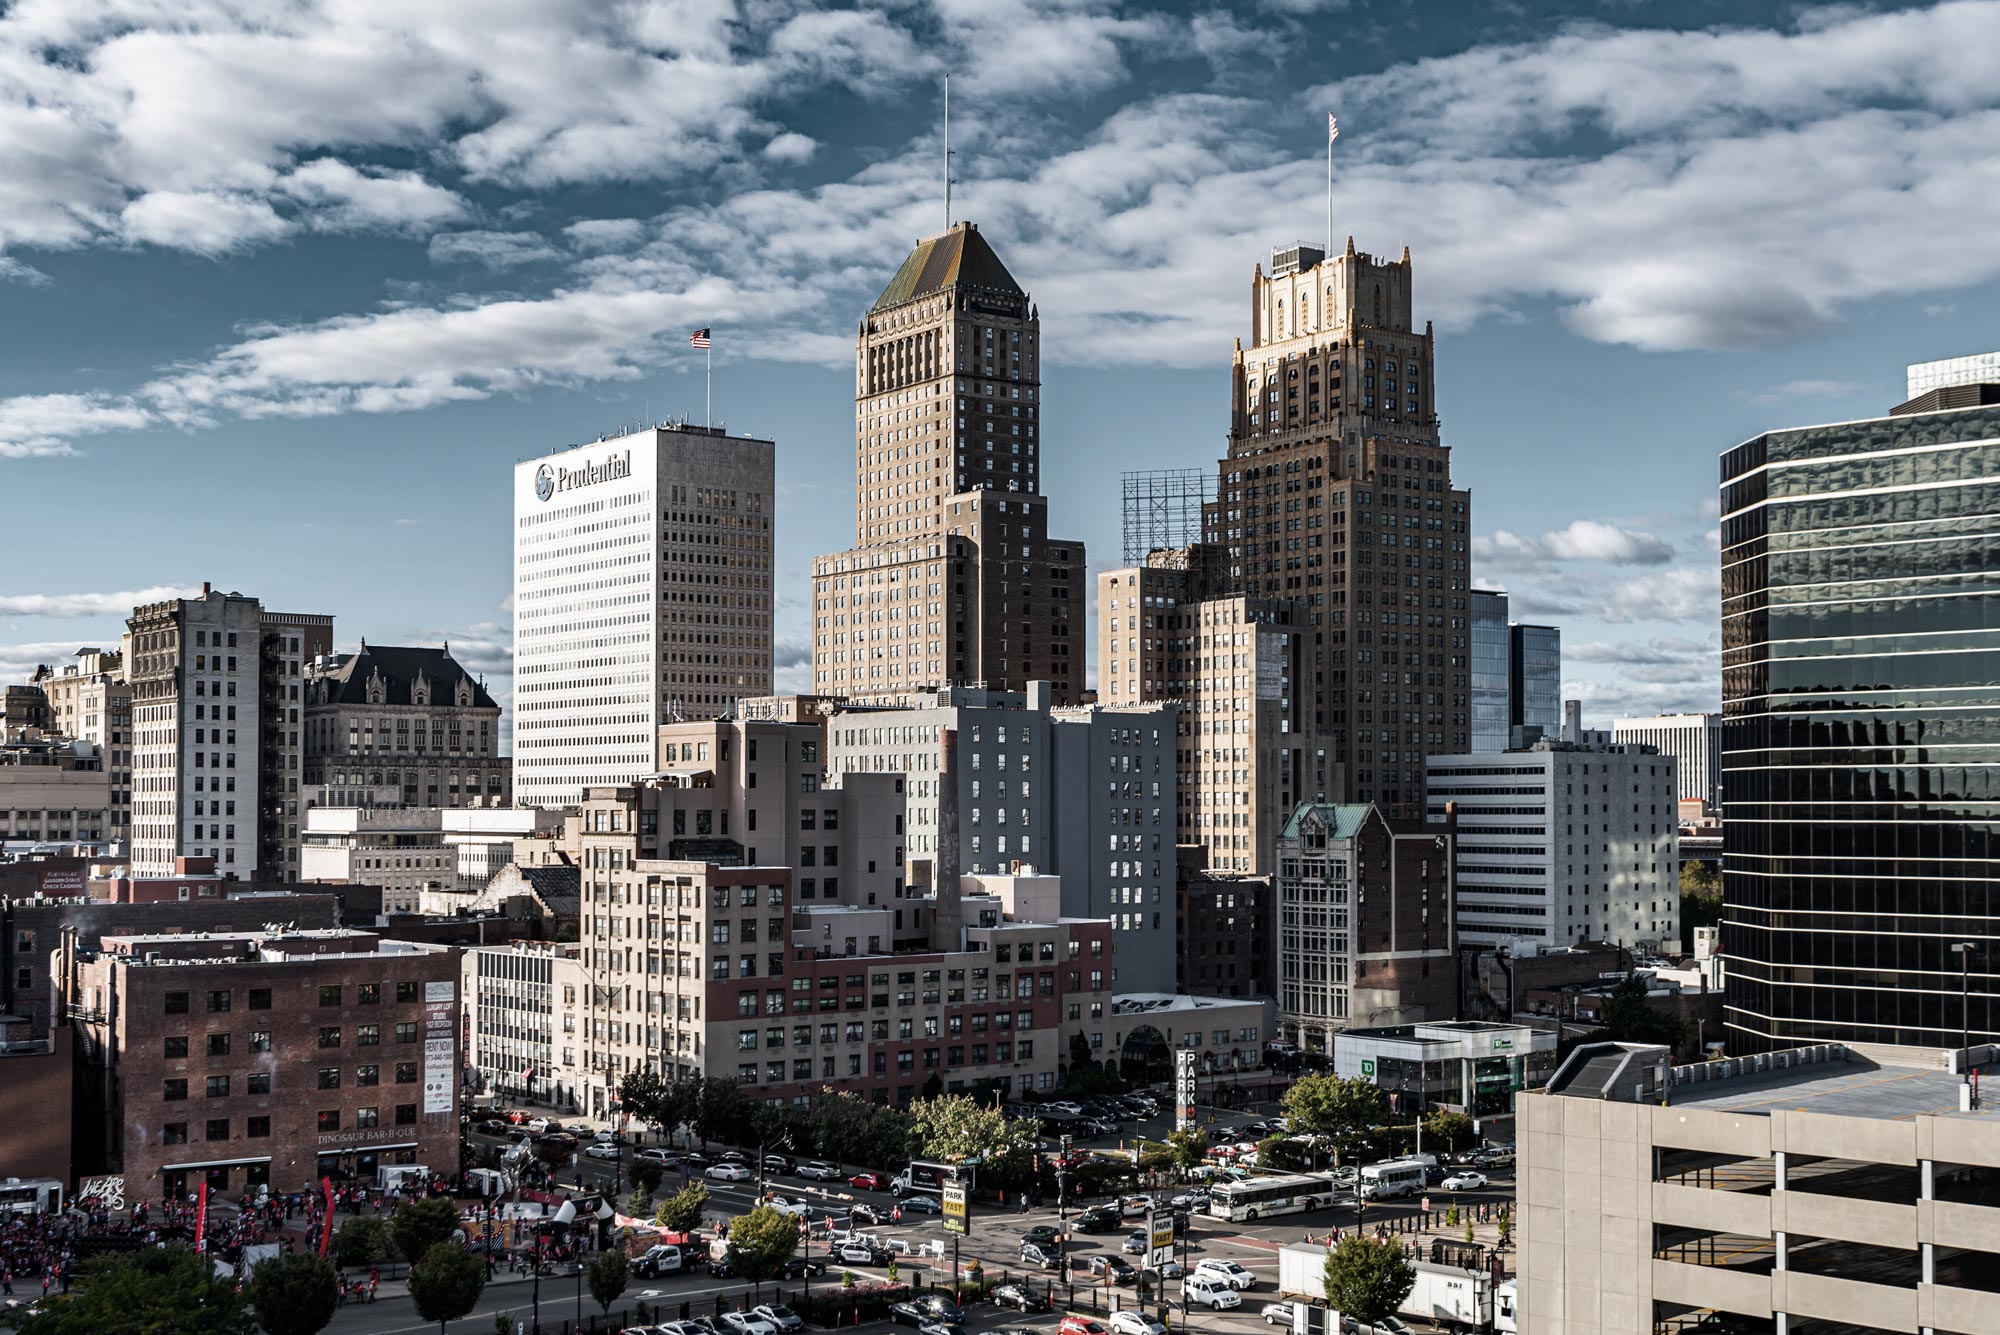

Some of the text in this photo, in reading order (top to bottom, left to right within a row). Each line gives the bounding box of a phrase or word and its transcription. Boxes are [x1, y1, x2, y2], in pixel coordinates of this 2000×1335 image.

[557, 449, 631, 492] Prudential
[426, 1041, 439, 1052] RENT
[1177, 1053, 1185, 1105] PARK
[1187, 1053, 1195, 1105] PARK
[318, 1132, 365, 1145] DINOSAUR
[945, 1190, 963, 1201] PARK
[945, 1202, 963, 1212] FAST
[1155, 1221, 1171, 1231] PARK
[1155, 1232, 1172, 1243] FAST
